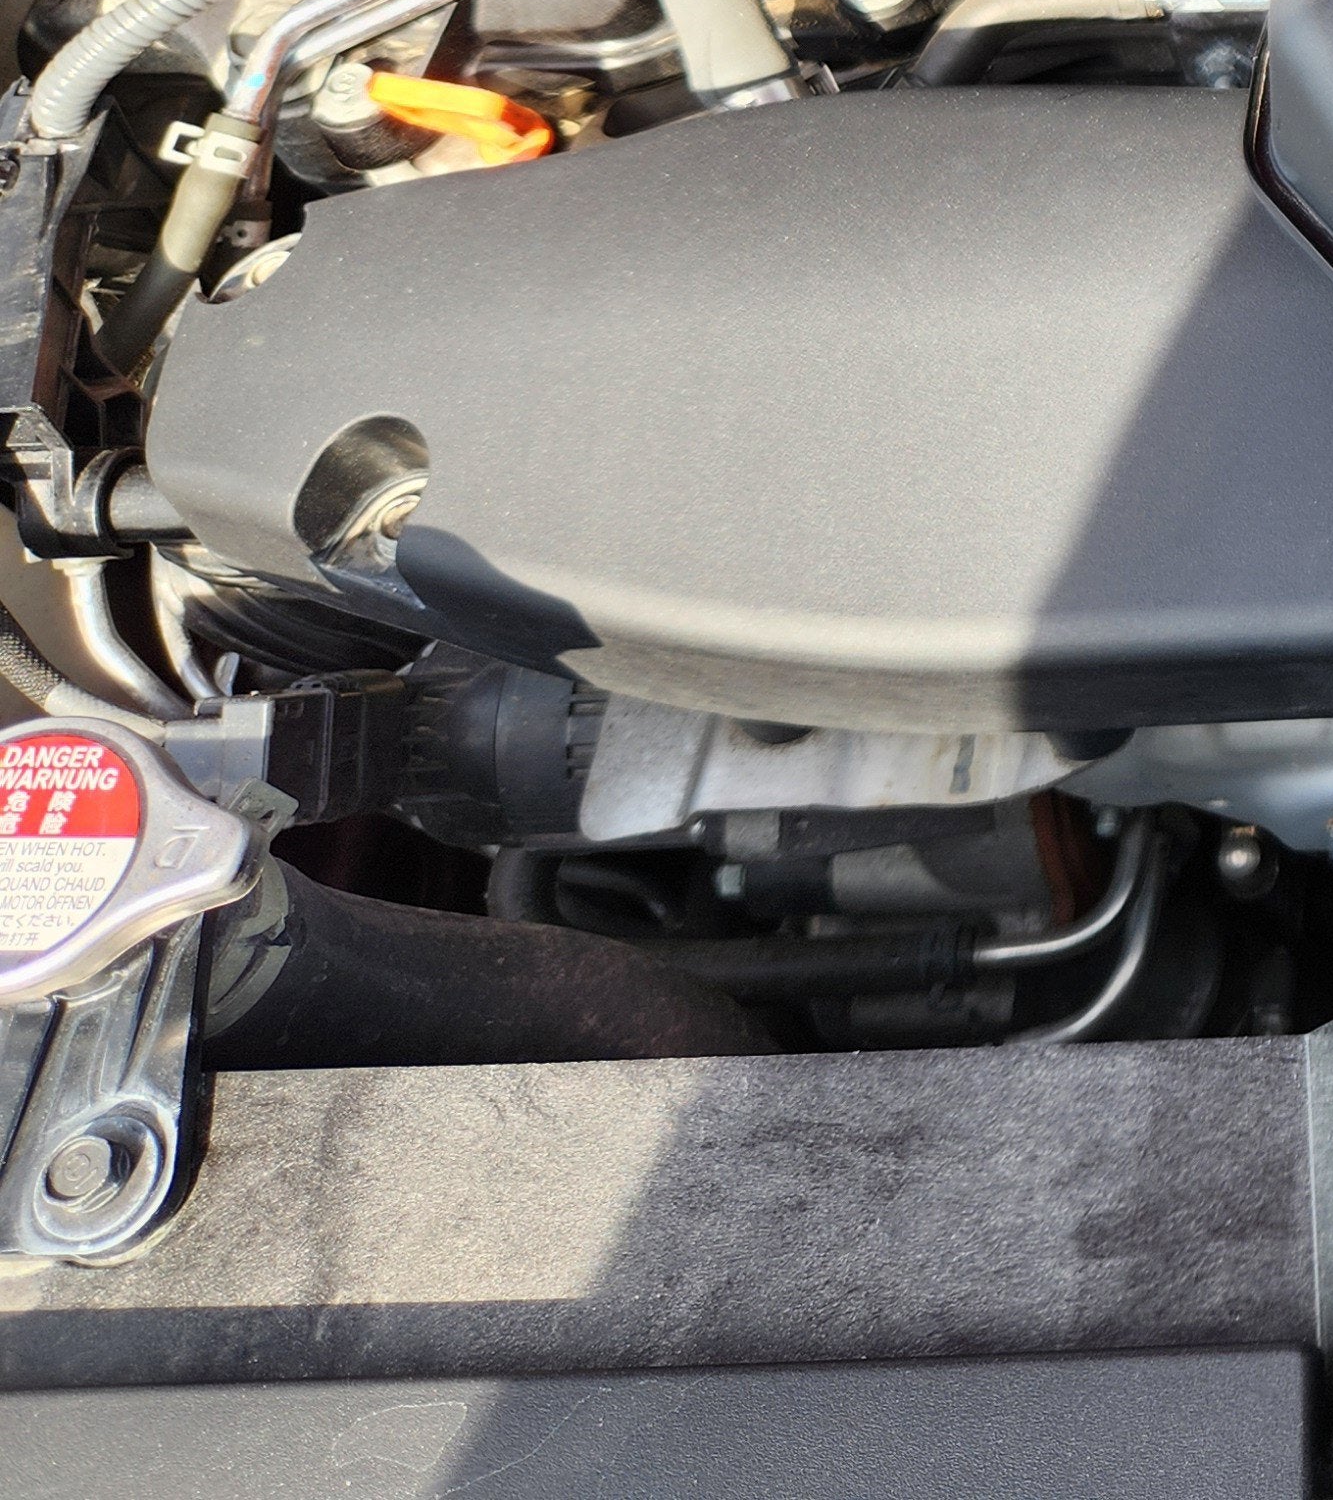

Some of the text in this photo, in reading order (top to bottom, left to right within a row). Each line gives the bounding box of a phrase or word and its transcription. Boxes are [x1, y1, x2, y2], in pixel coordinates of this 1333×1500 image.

[2, 745, 104, 769] DANGER
[0, 767, 119, 791] WARNUNG
[21, 842, 69, 856] WHEN
[70, 842, 106, 857] HOT.
[16, 859, 54, 873] scald
[54, 862, 84, 876] you.
